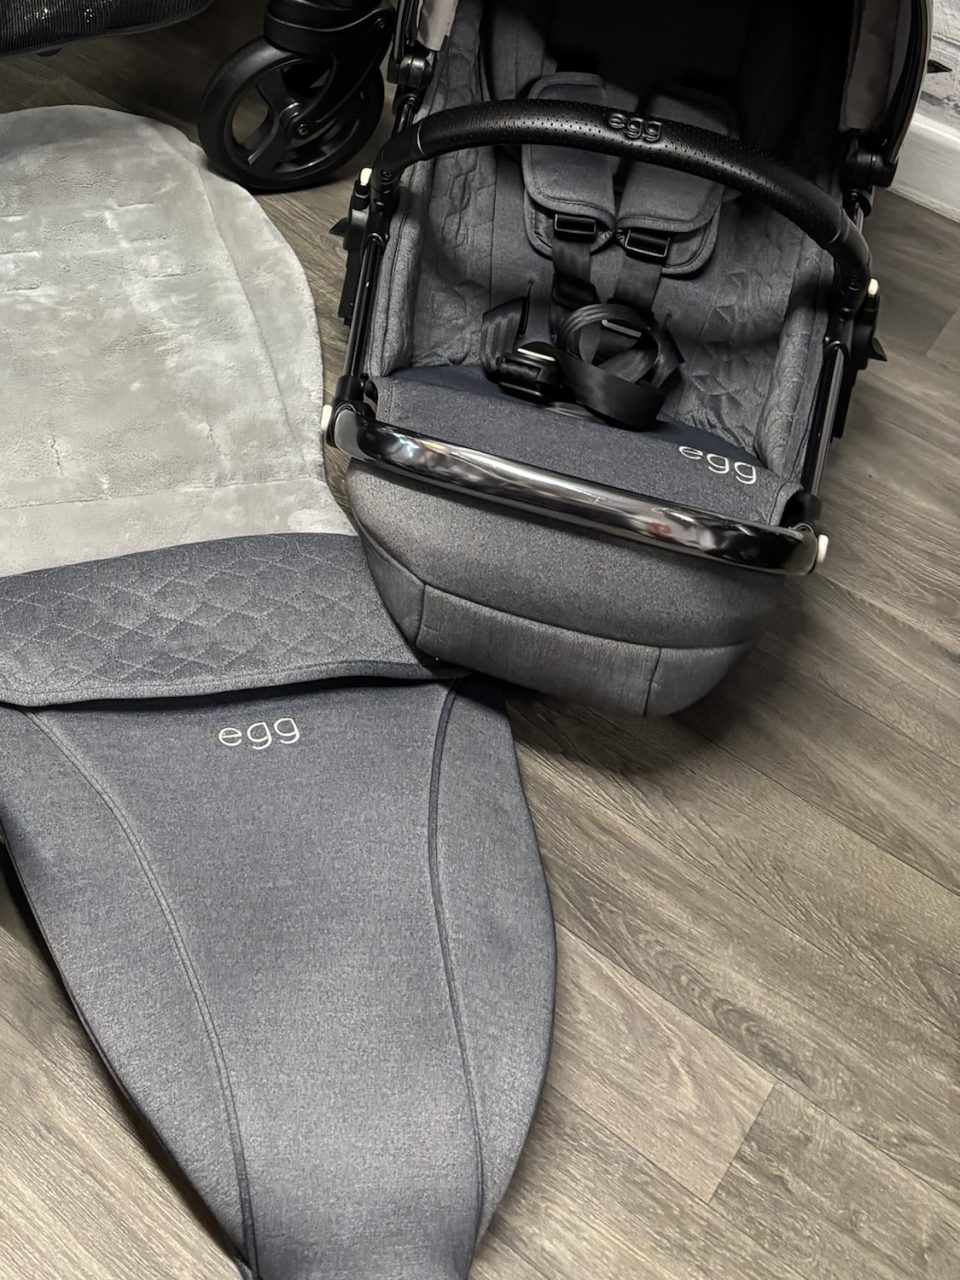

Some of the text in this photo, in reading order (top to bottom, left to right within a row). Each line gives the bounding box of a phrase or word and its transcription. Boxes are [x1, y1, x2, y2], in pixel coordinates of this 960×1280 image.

[608, 113, 663, 142] egg
[678, 446, 757, 485] egg
[218, 717, 300, 750] egg
